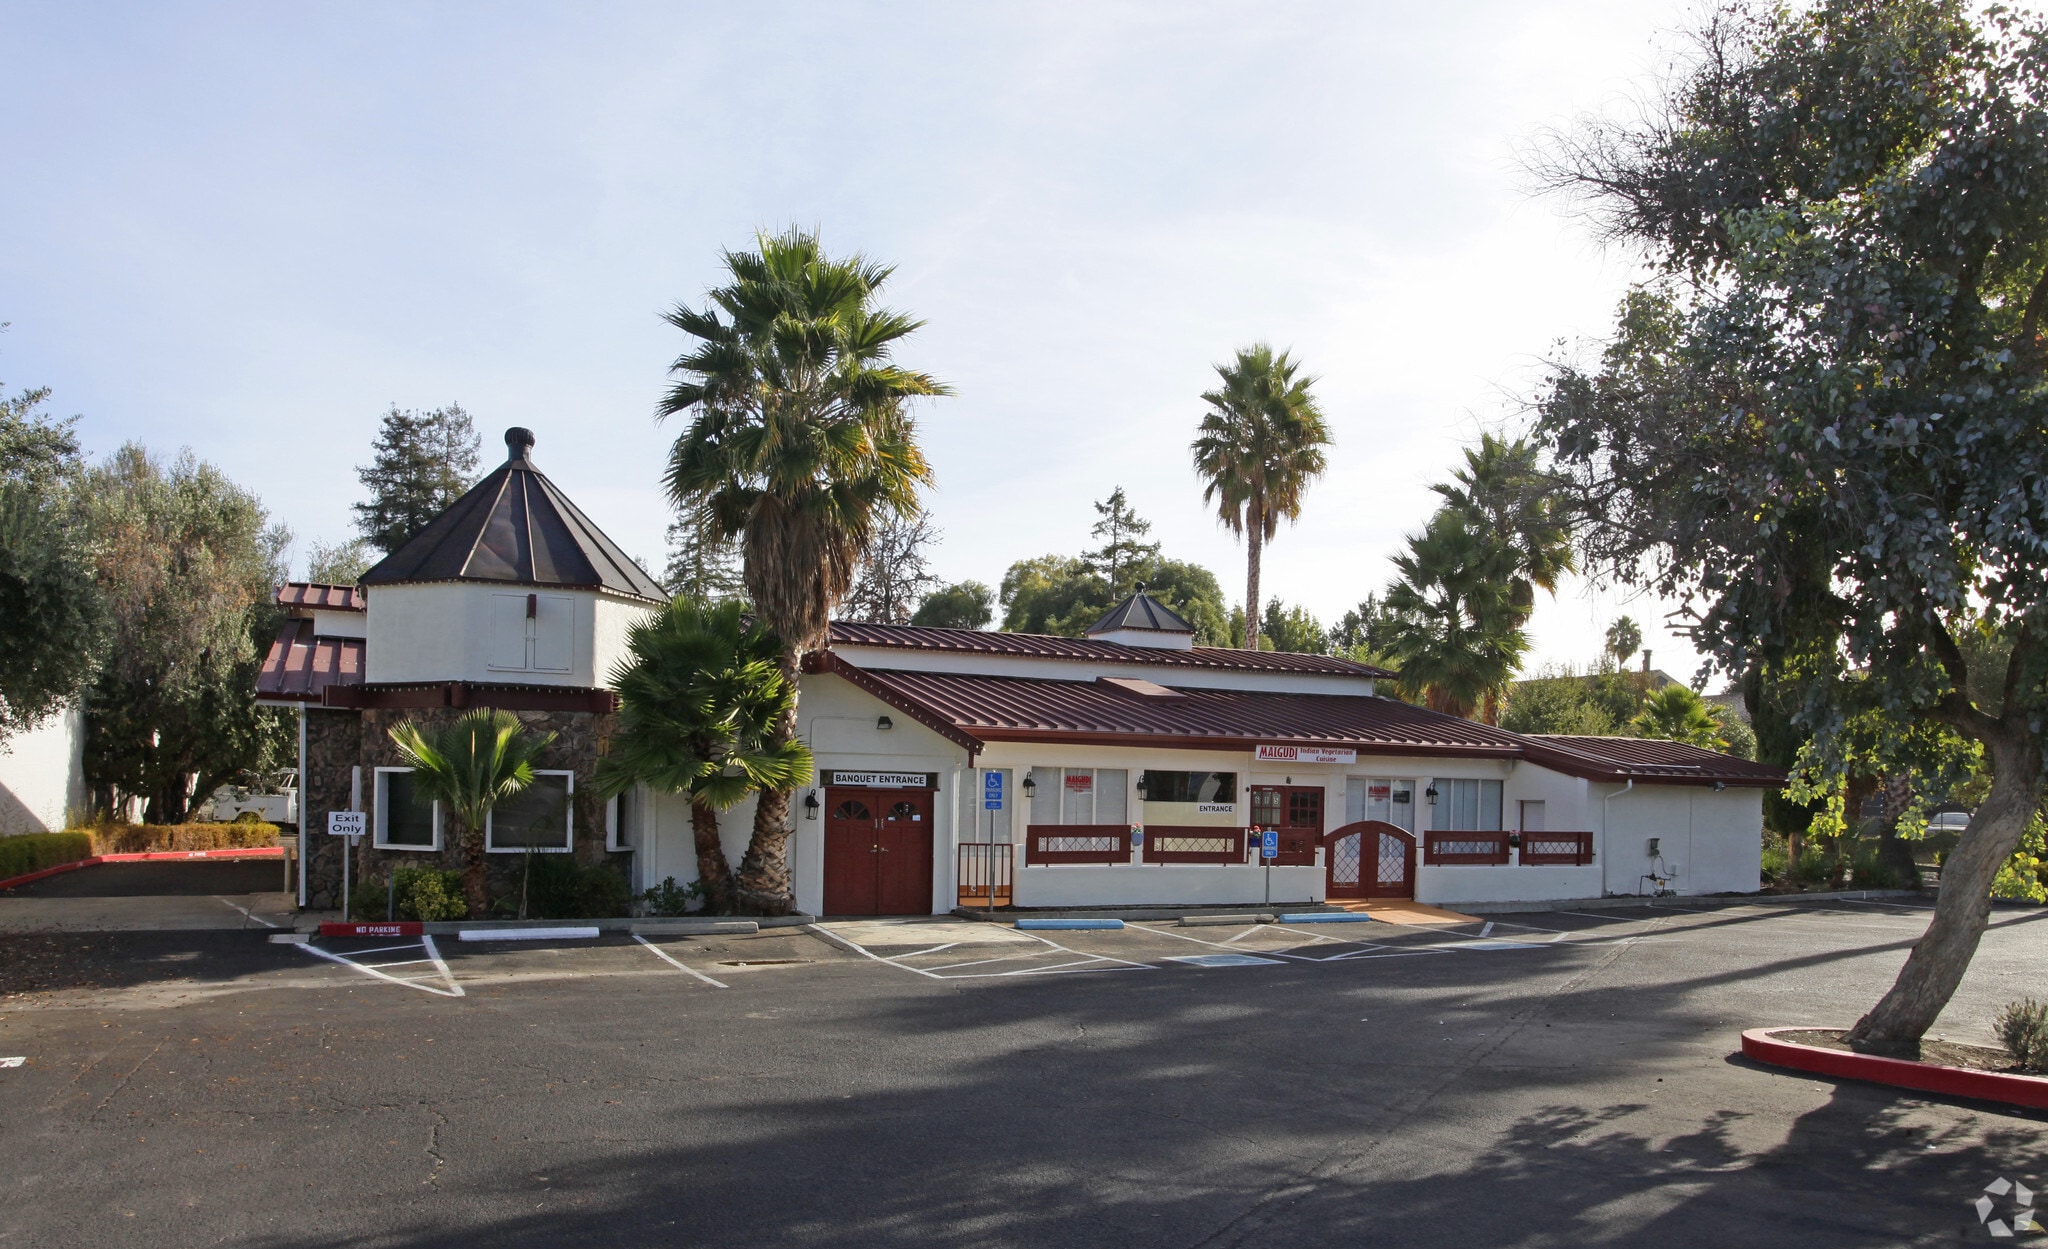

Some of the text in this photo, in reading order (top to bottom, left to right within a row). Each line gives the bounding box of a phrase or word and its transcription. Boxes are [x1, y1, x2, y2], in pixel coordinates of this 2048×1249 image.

[1259, 746, 1353, 760] MALGUDI Indian Vegetarian
[835, 774, 924, 785] BANQUET ENTRANCE
[1199, 805, 1233, 813] ENTRANCE
[335, 814, 360, 822] Exit
[332, 824, 362, 834] Only
[356, 926, 401, 934] NO PARKING
